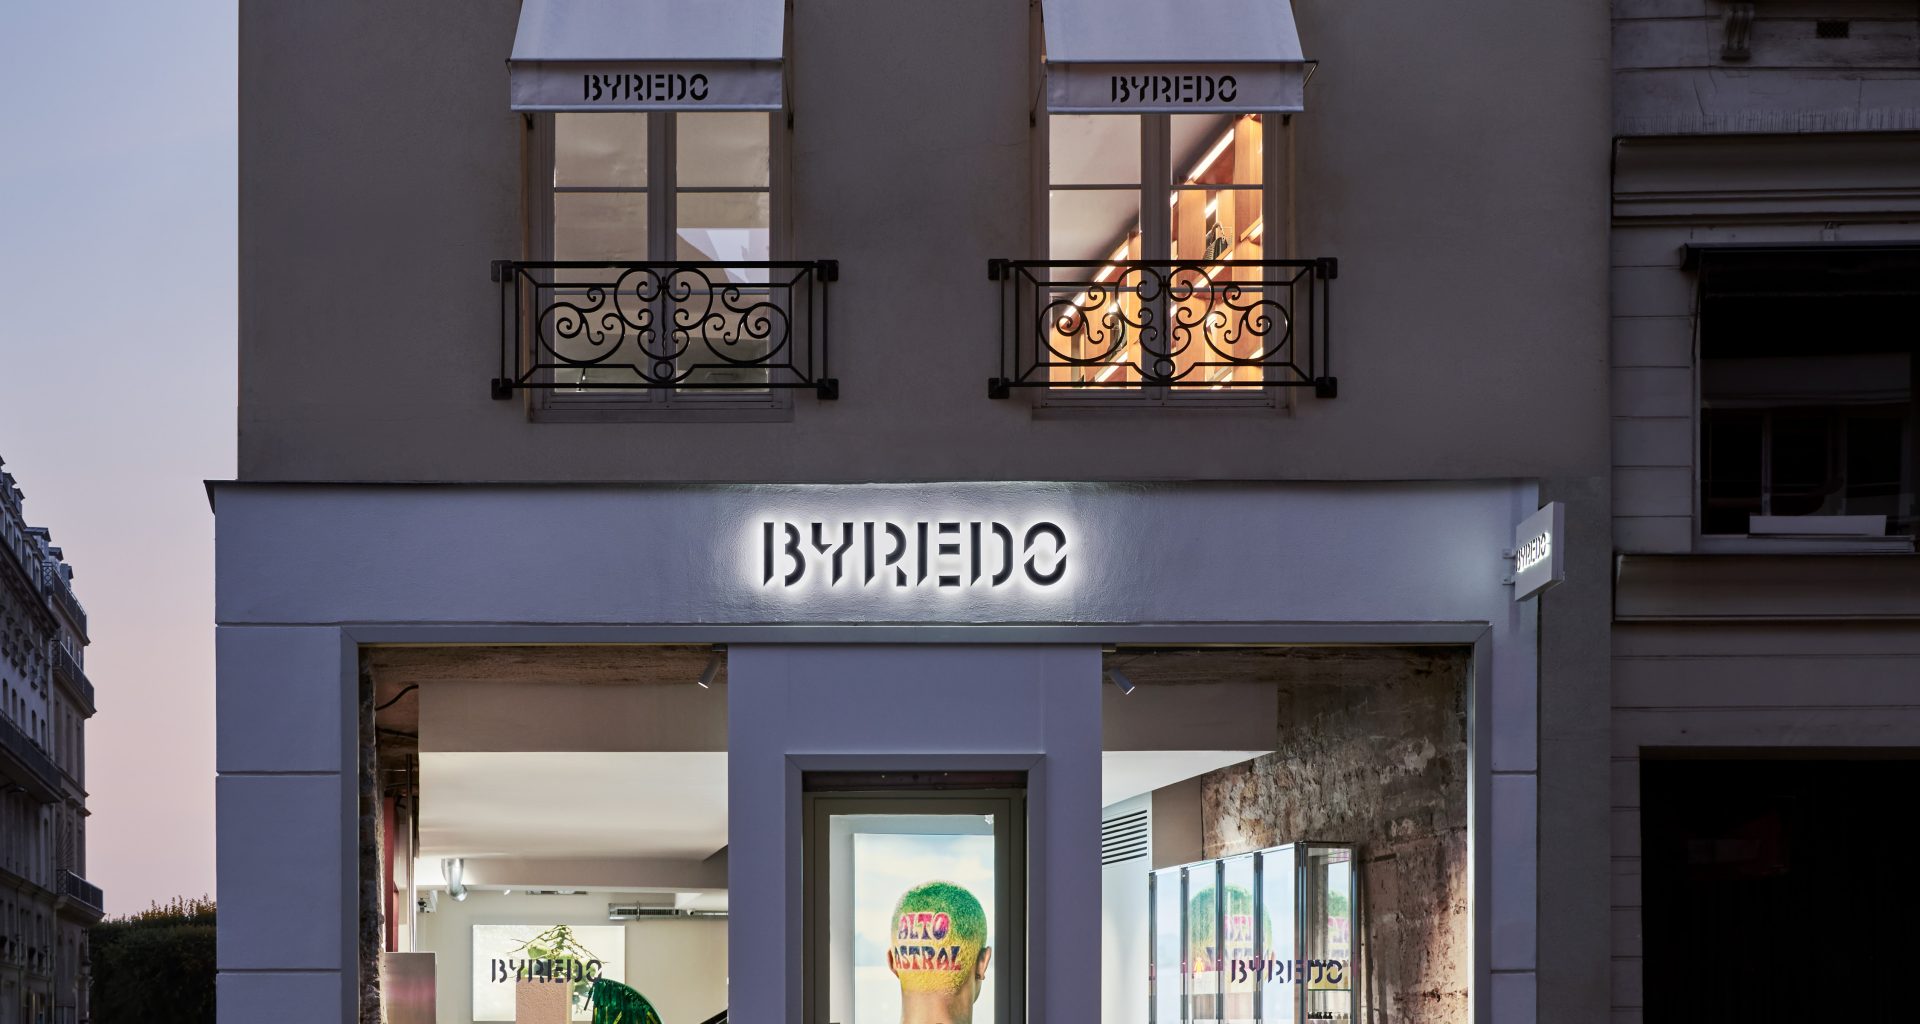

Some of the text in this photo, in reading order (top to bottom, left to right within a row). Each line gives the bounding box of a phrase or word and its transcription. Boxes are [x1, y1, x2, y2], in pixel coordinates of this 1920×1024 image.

[584, 74, 708, 101] BYREDO
[1112, 75, 1237, 102] BYREDO
[763, 521, 1067, 587] BYREDO
[1516, 532, 1547, 572] BYREDO
[898, 912, 950, 940] ALTO
[491, 959, 603, 984] BYREDO
[894, 945, 961, 971] ASTRAL
[1231, 959, 1343, 984] BYREDO
